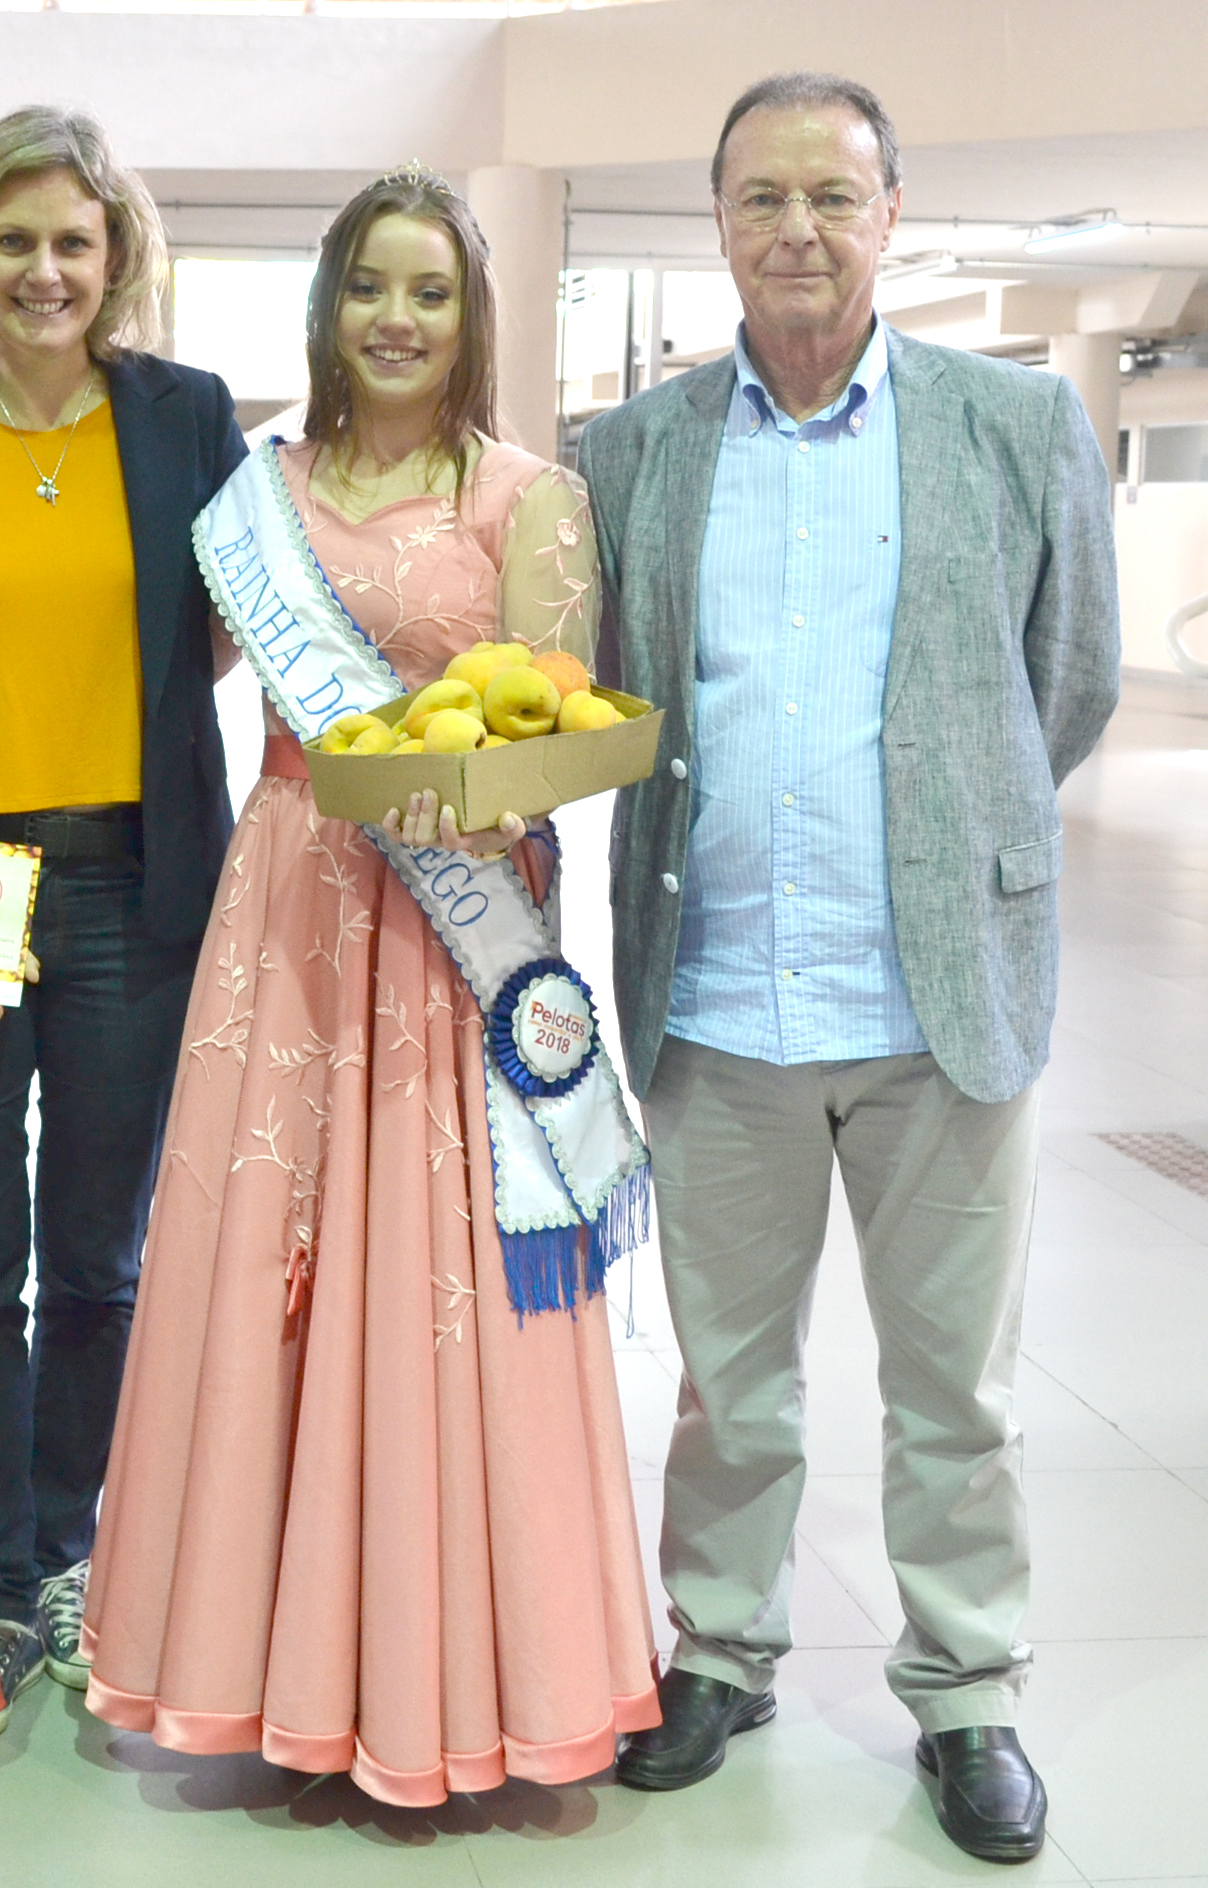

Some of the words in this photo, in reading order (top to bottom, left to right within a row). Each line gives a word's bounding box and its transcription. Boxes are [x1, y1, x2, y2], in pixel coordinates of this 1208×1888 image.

[214, 526, 311, 679] RAINHA
[530, 1000, 585, 1038] Pelotas
[535, 1028, 571, 1054] 2018
